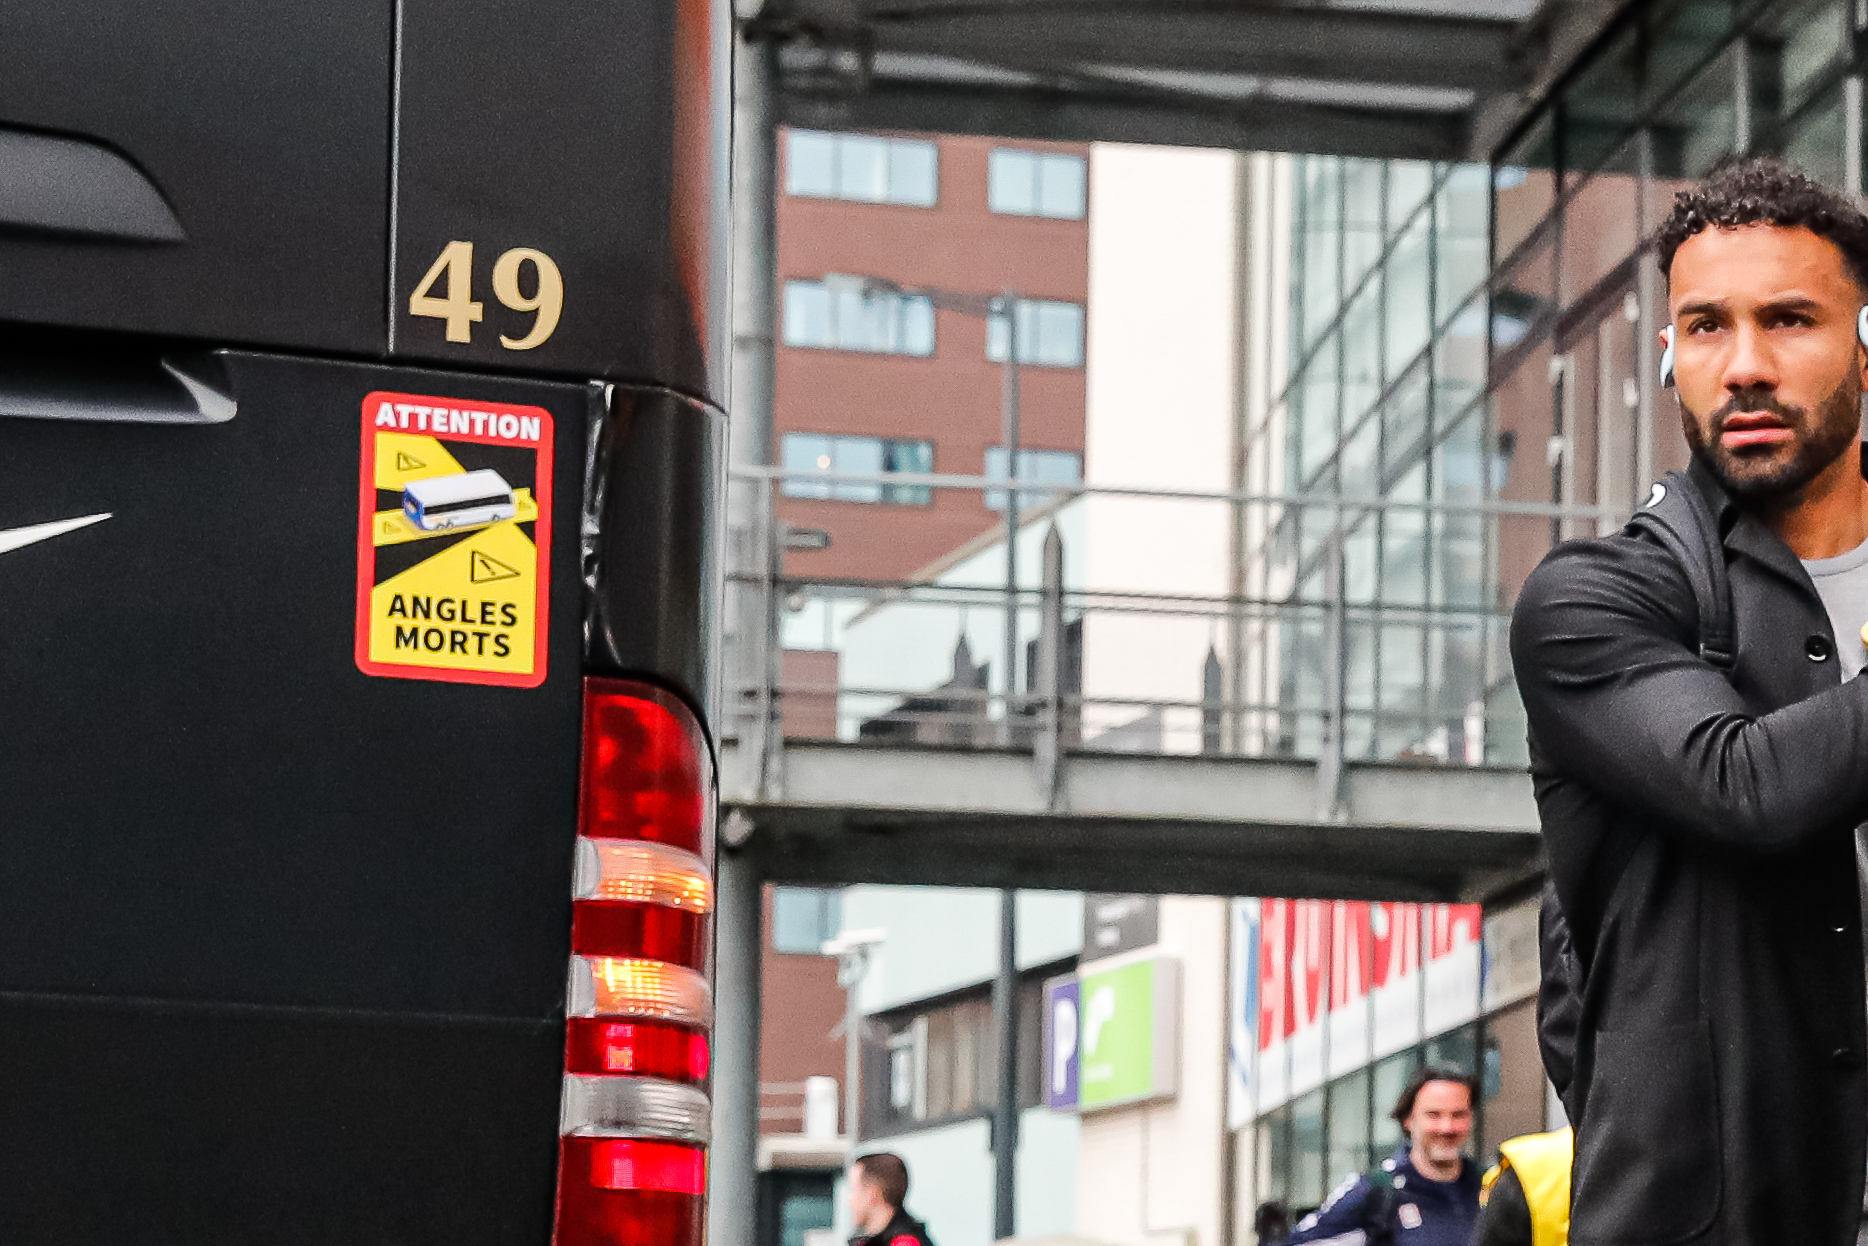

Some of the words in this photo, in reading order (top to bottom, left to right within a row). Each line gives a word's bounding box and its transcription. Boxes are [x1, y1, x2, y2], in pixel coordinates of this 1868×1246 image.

[409, 241, 564, 350] 49
[375, 402, 541, 441] ATTENTION
[387, 593, 517, 627] ANGLES
[395, 626, 510, 658] MORTS
